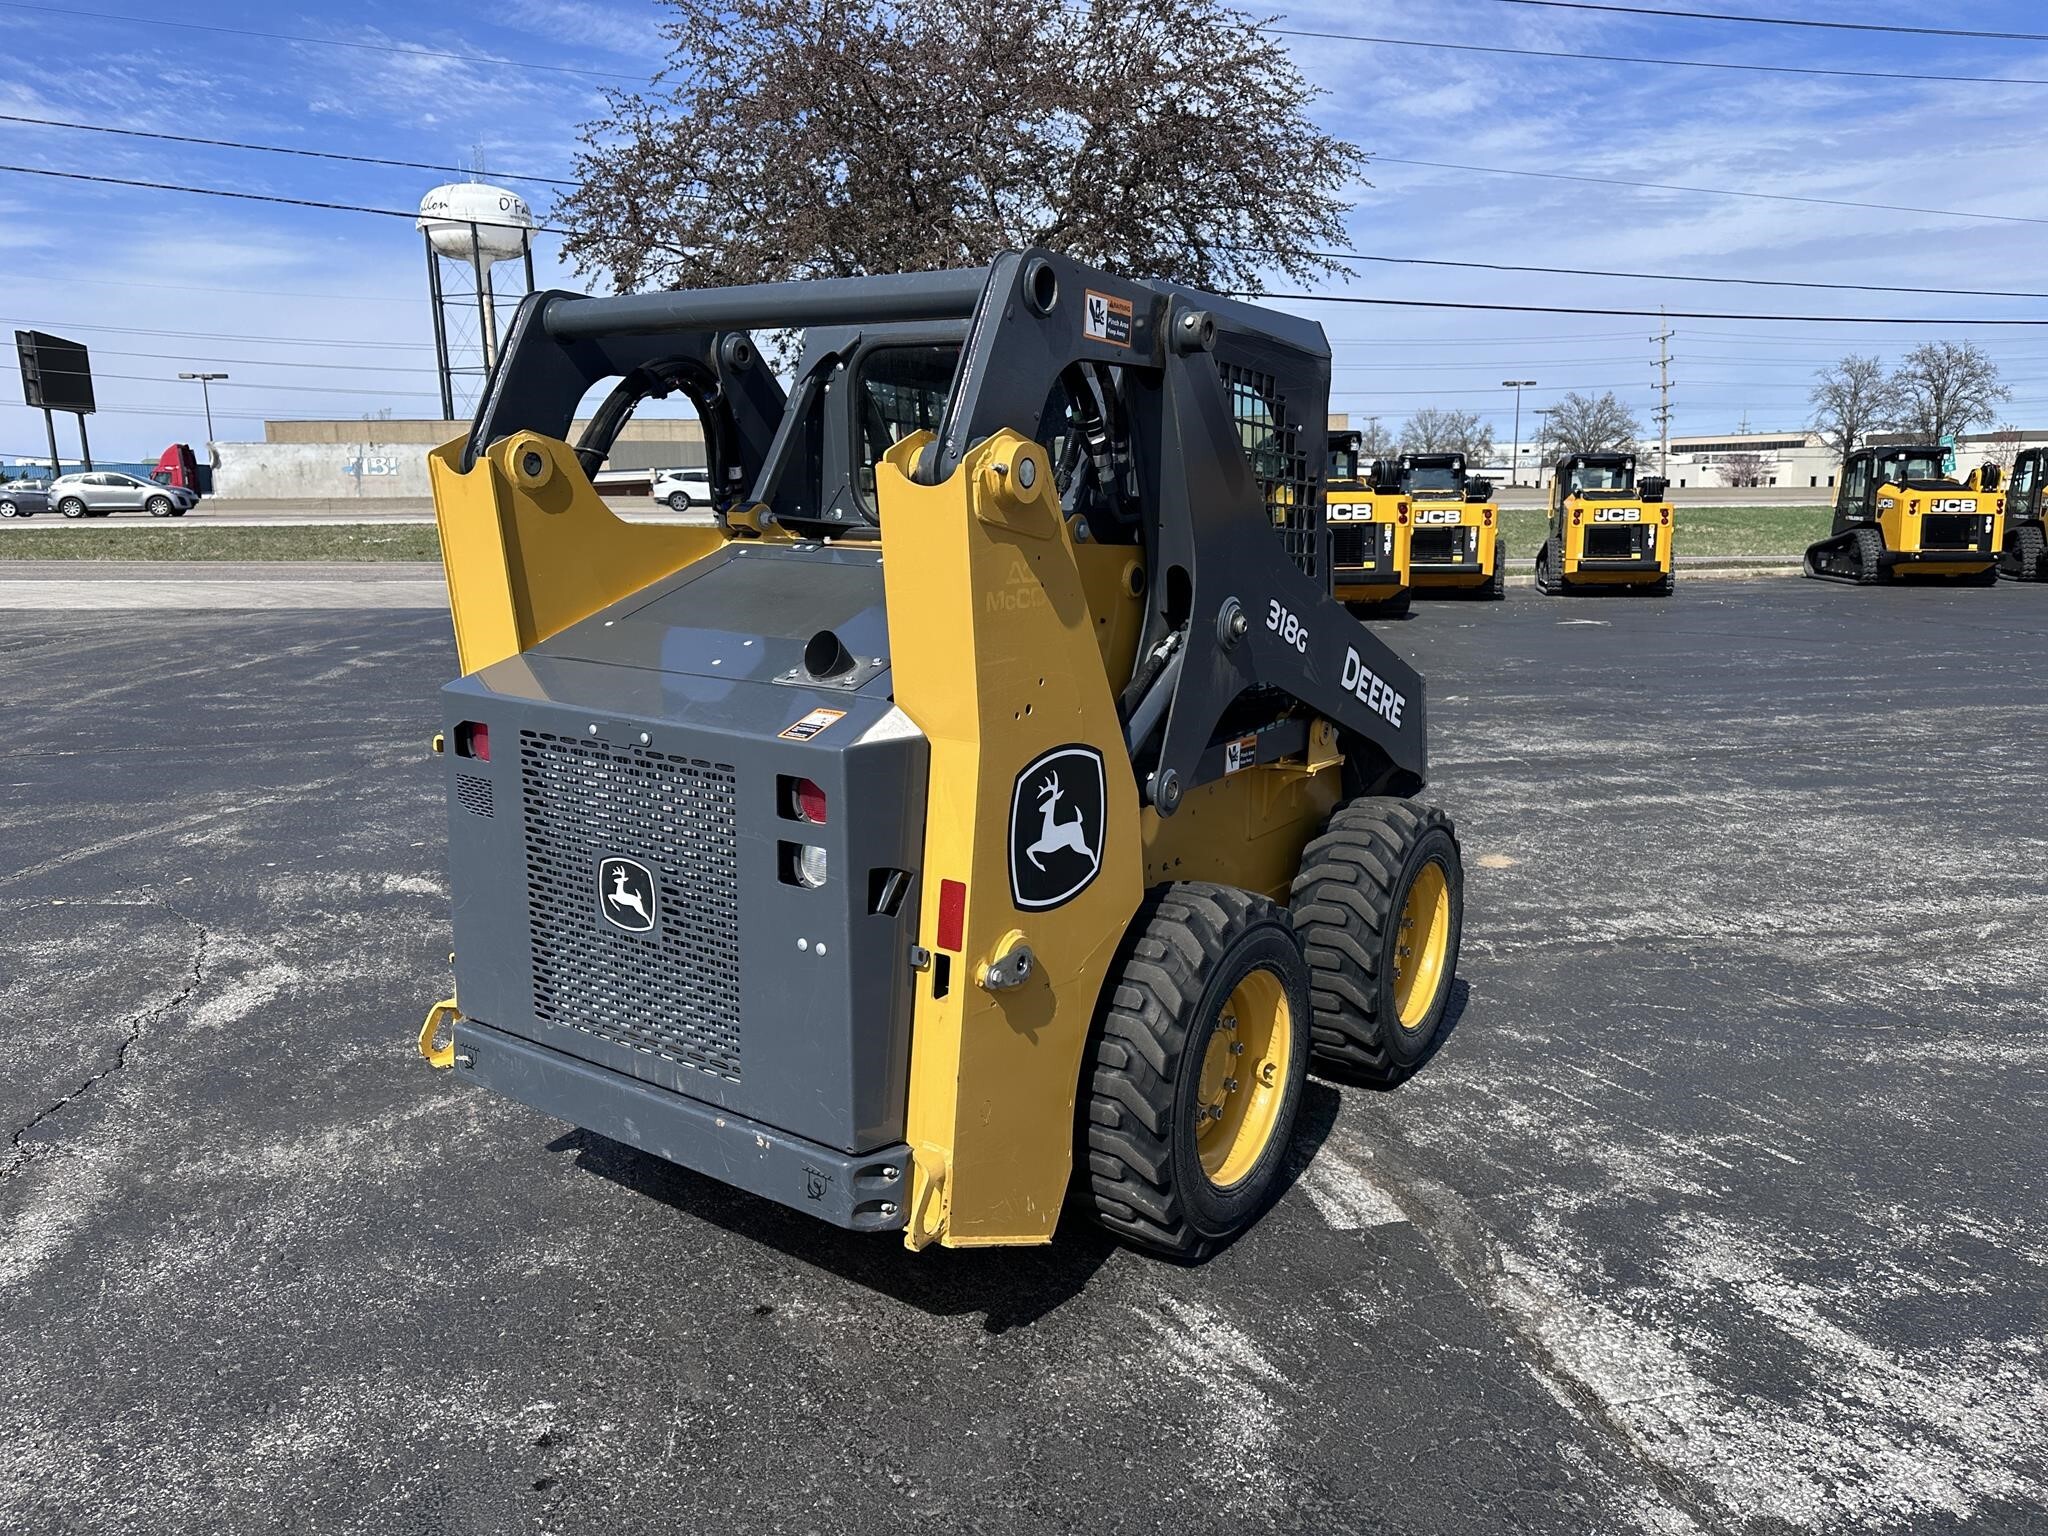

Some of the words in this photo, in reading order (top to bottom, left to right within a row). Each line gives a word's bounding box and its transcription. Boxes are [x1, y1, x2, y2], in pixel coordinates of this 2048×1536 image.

[1877, 498, 1894, 508] JCB
[1931, 499, 1977, 513] JCB
[1415, 510, 1461, 524] JCB
[1594, 508, 1640, 522] JCB
[1265, 599, 1309, 653] 318G
[1340, 646, 1406, 729] DEERE
